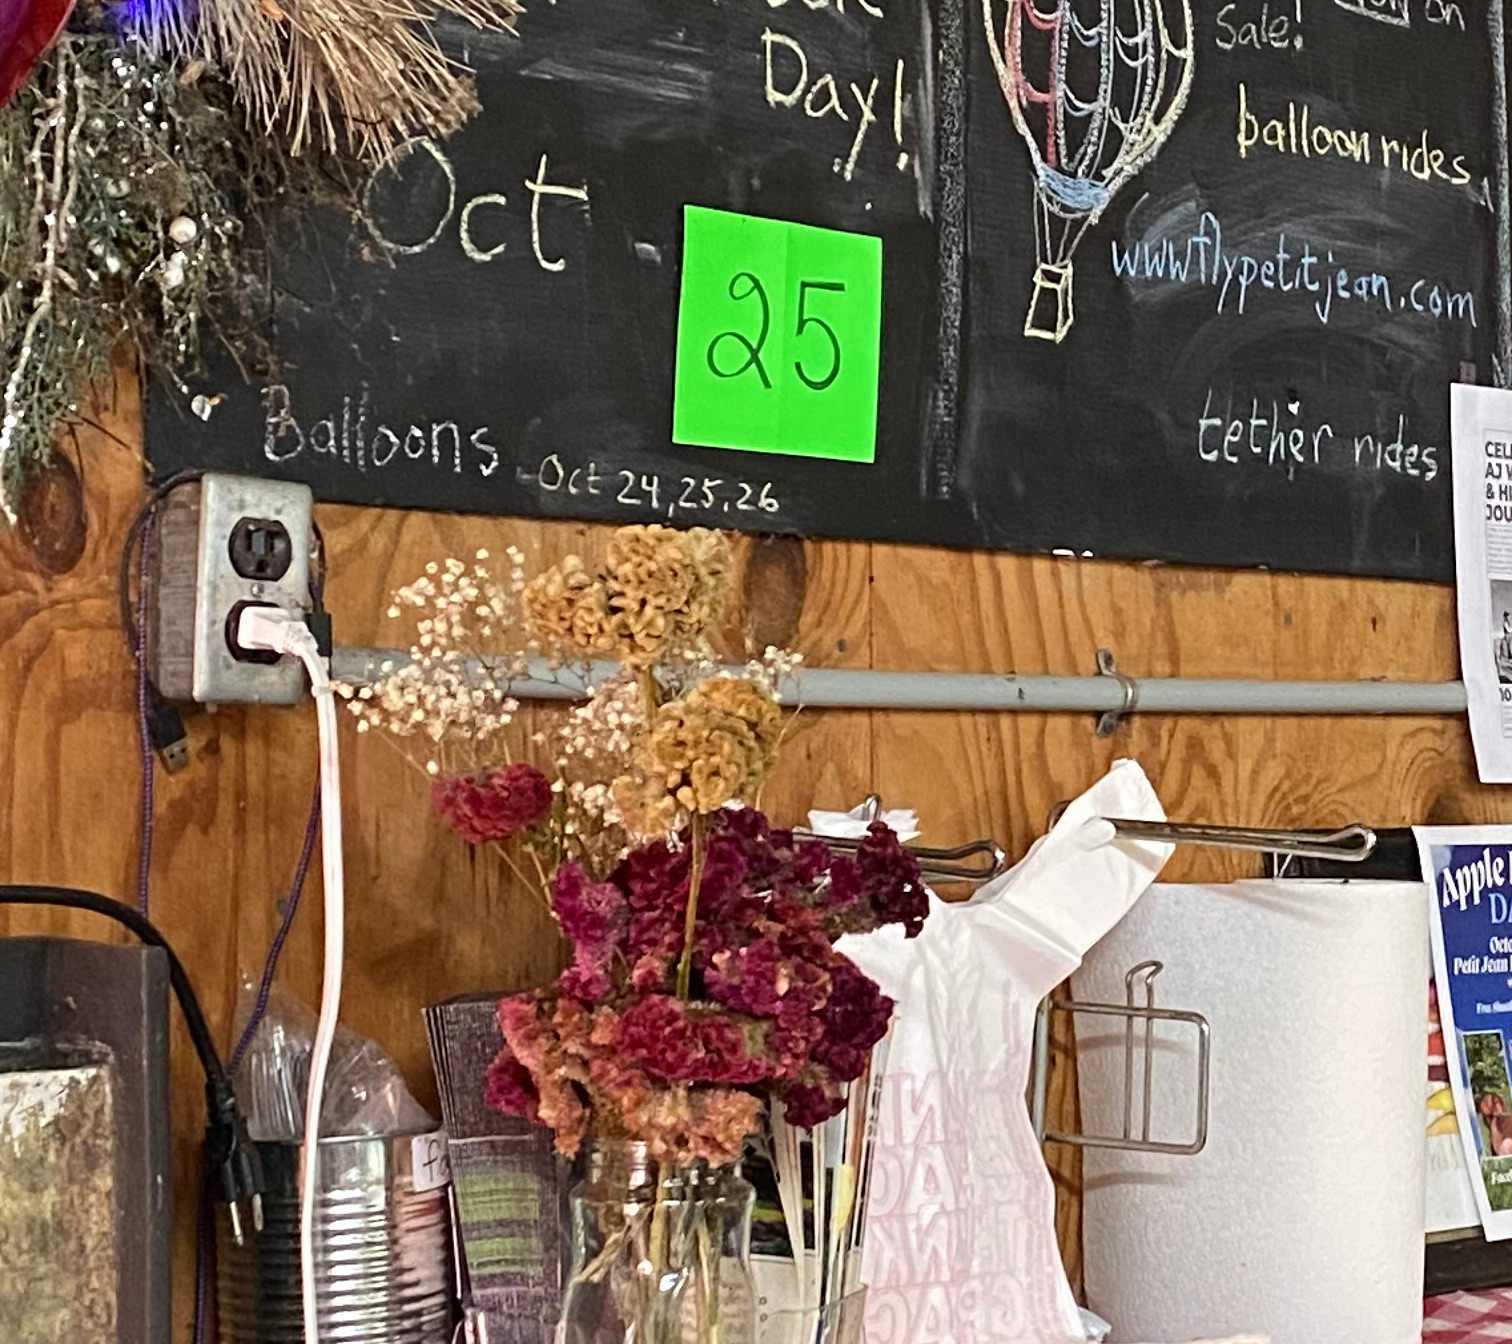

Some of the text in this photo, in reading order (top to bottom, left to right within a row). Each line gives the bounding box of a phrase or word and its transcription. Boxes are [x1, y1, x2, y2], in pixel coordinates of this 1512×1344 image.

[762, 27, 908, 181] Day!
[1236, 83, 1369, 168] balloon
[364, 135, 589, 271] Oct
[707, 272, 846, 391] 25
[261, 384, 499, 476] Balloons
[1197, 387, 1440, 483] tether rides
[1484, 462, 1503, 481] AJ
[1485, 485, 1496, 500] &
[1440, 847, 1505, 912] Apple
[1453, 954, 1479, 976] Petit
[1480, 953, 1508, 974] Jean
